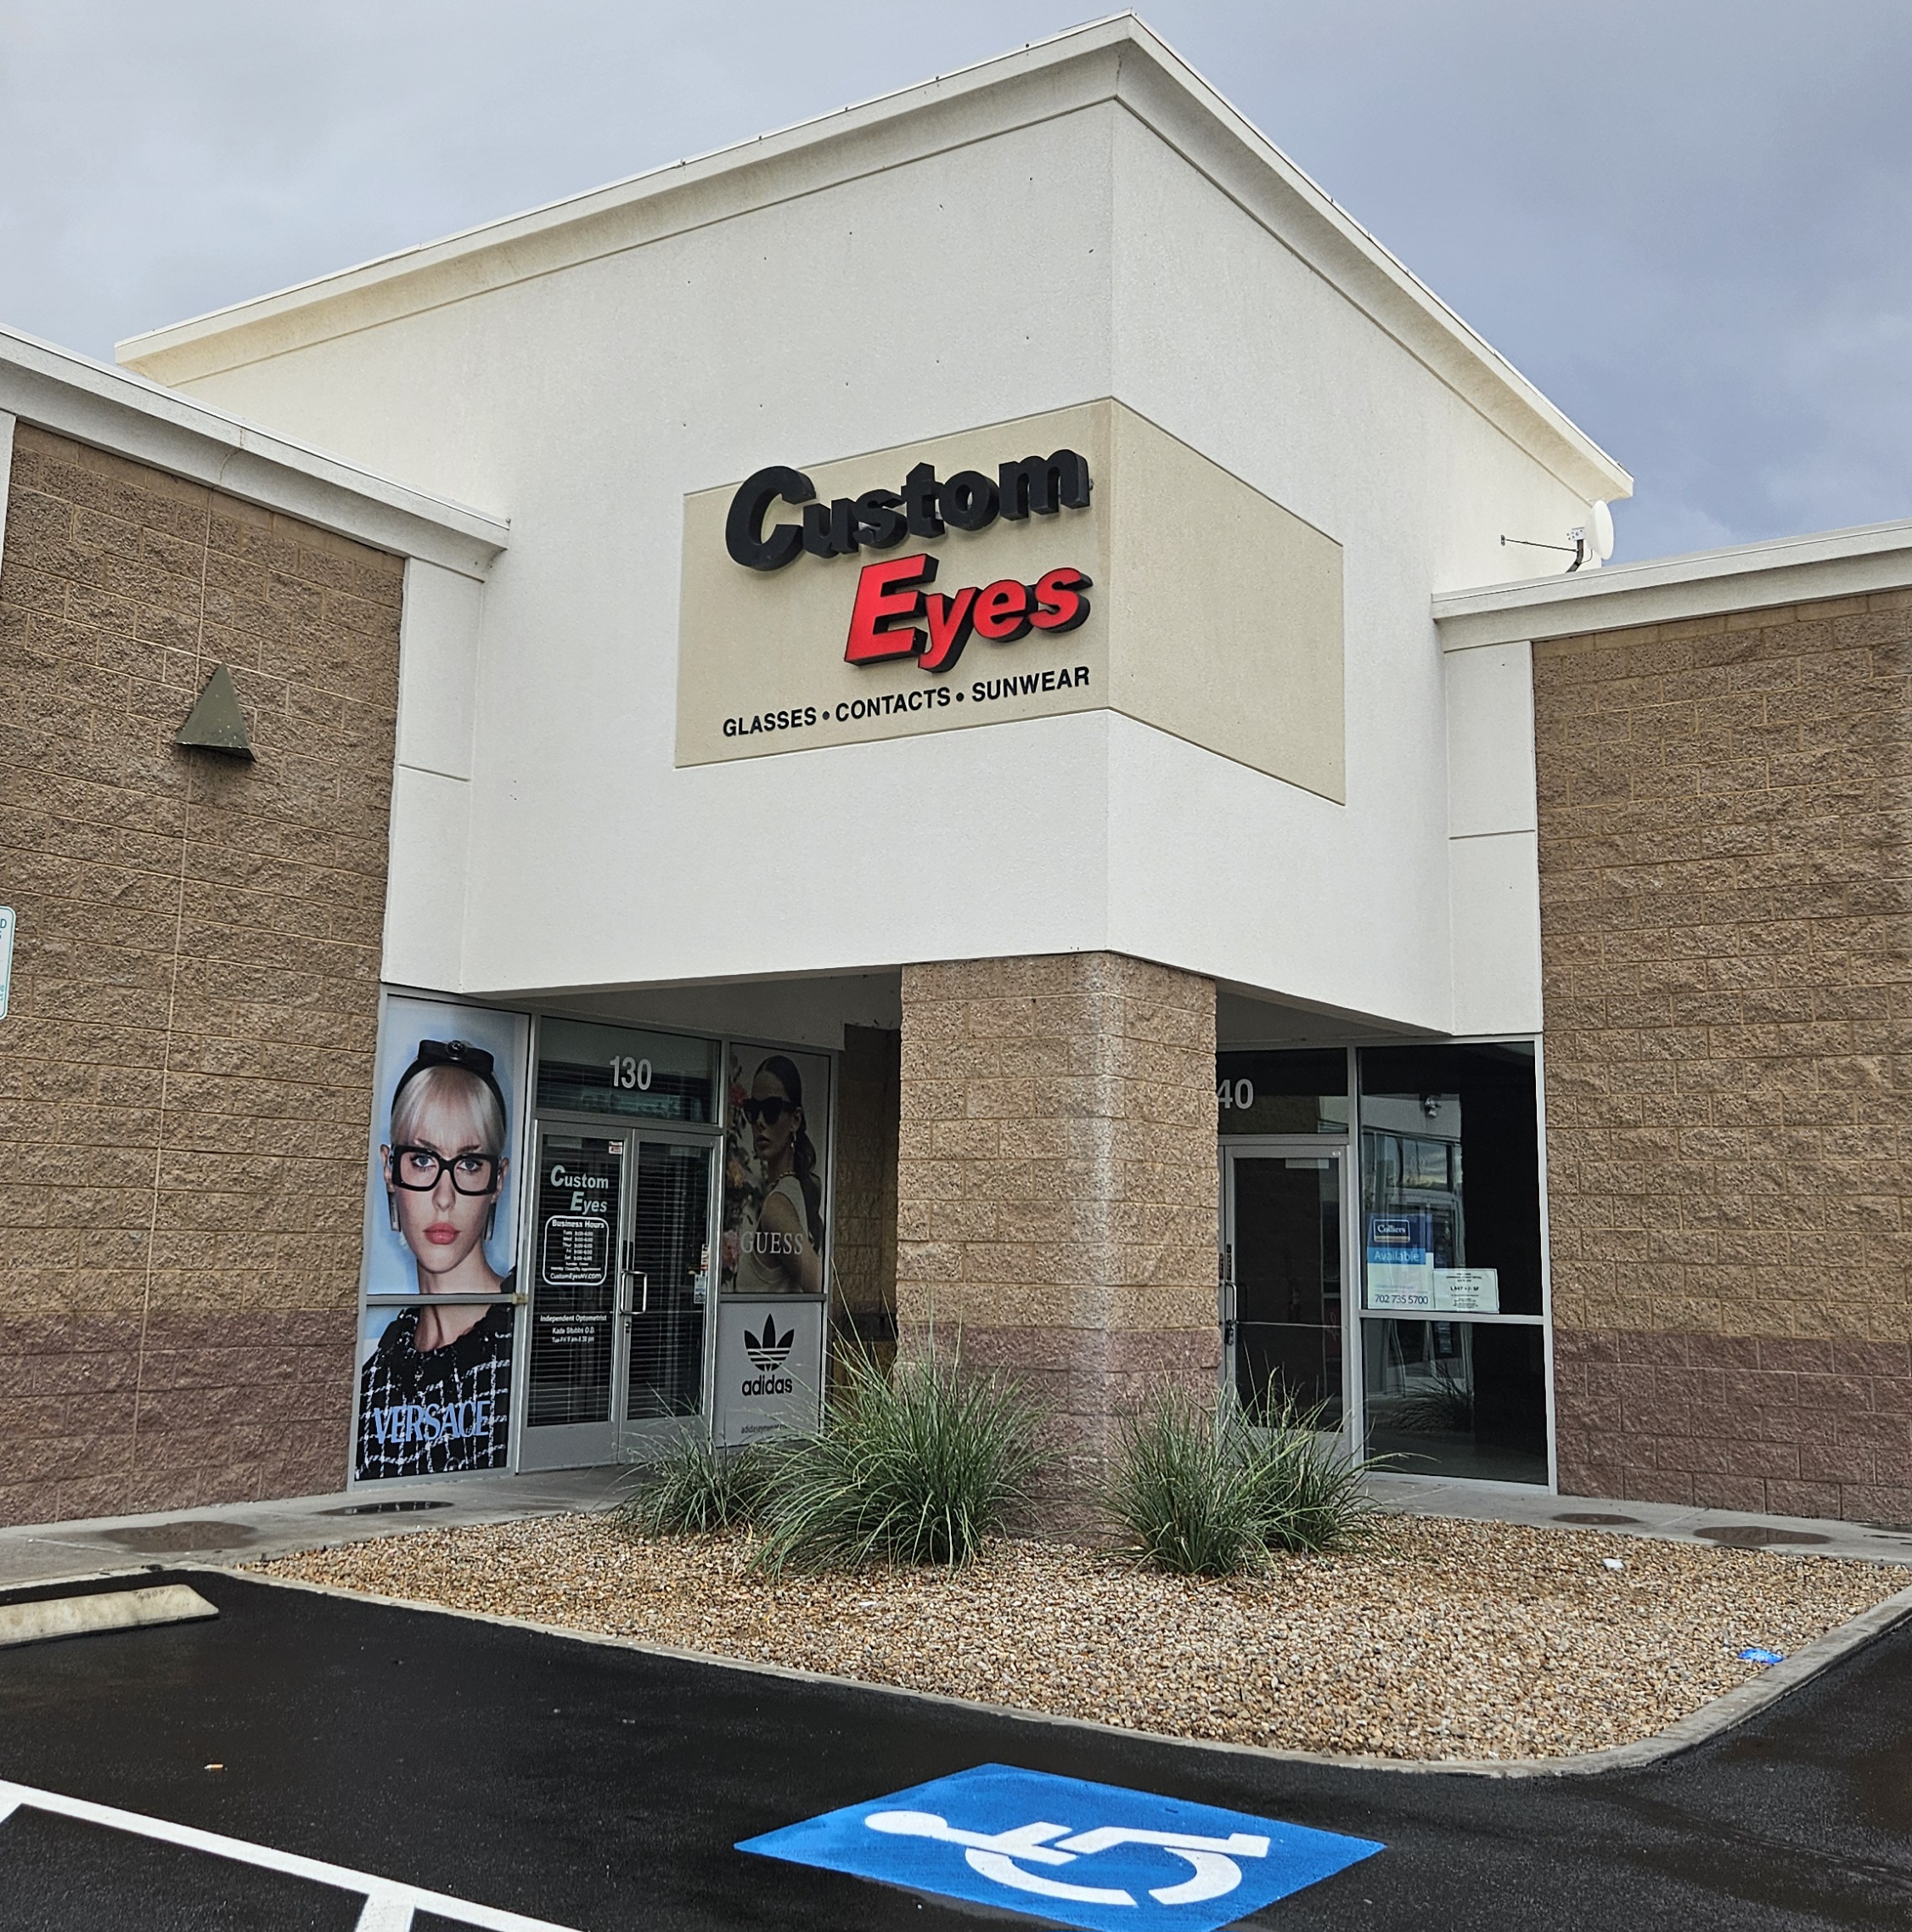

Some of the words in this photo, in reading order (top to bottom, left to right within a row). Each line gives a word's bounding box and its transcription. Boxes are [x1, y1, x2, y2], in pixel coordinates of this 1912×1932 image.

[725, 449, 1091, 571] Custom
[844, 554, 1093, 673] Eyes
[723, 707, 817, 737] GLASSES
[835, 686, 950, 722] CONTACTS
[971, 666, 1090, 702] SUNWEAR
[610, 1056, 652, 1090] 130
[1217, 1079, 1253, 1109] 40
[550, 1164, 609, 1189] Custom
[570, 1191, 608, 1215] Eyes
[552, 1219, 583, 1228] Business
[584, 1220, 605, 1229] Hours
[1377, 1225, 1406, 1233] Colliers
[740, 1231, 803, 1255] GUESS
[1375, 1251, 1419, 1261] Available
[1375, 1294, 1390, 1303] 702
[1392, 1295, 1407, 1304] 735
[1409, 1295, 1428, 1304] 5700
[540, 1315, 575, 1323] Independent
[741, 1374, 793, 1396] adidas
[374, 1400, 491, 1444] VERSACE
